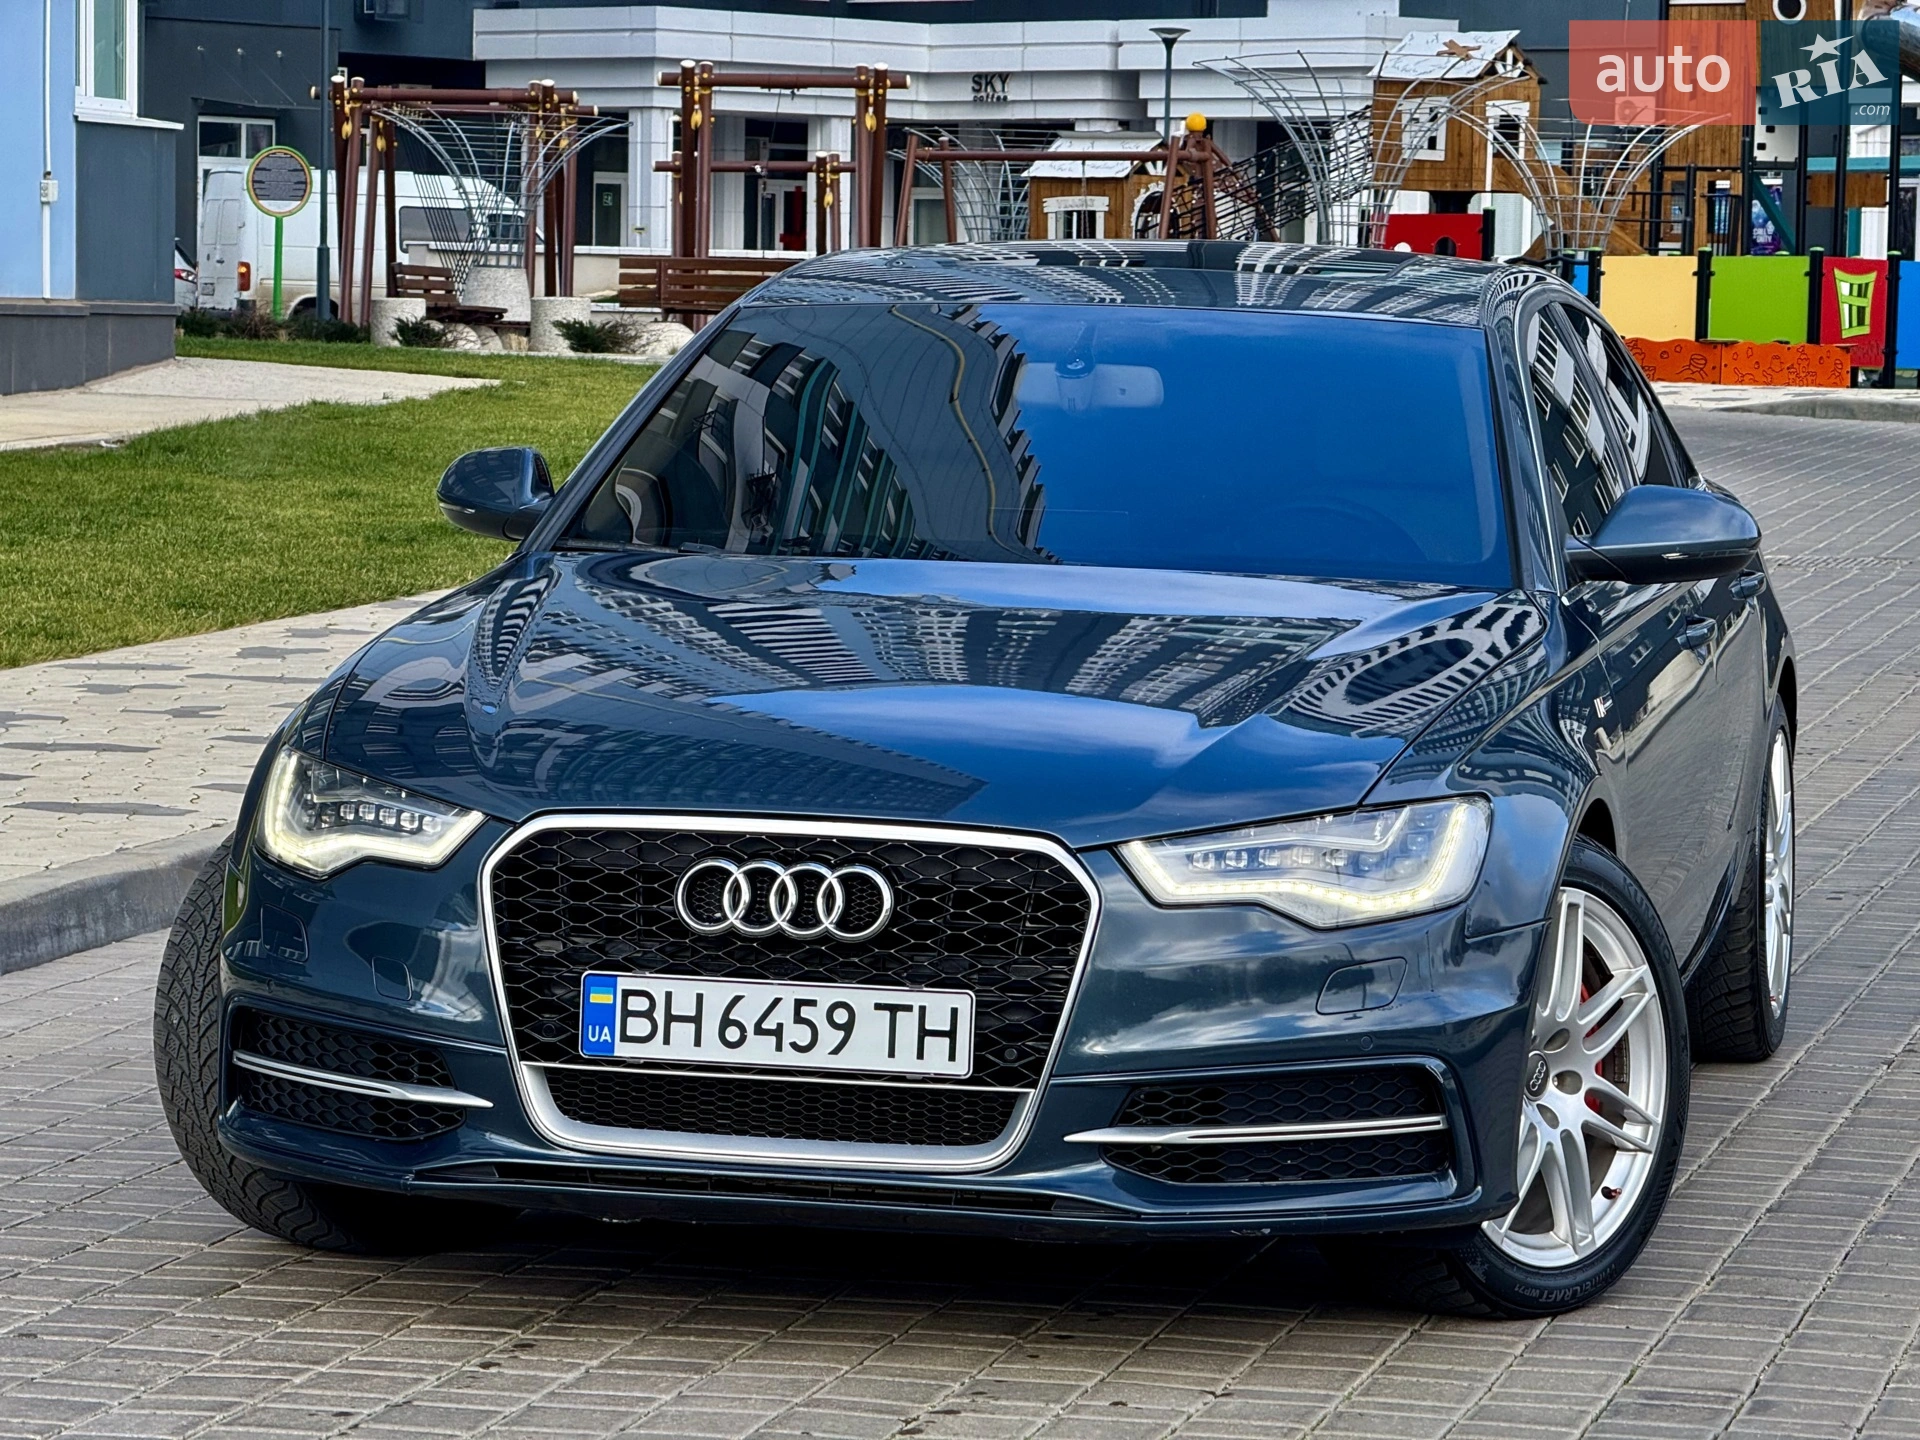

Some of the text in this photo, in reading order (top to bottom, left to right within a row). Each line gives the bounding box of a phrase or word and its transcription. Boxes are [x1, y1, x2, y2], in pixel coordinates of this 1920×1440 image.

[971, 73, 1011, 93] SKY
[973, 93, 1008, 102] coffee
[1623, 875, 1671, 965] KUMHO
[588, 1024, 612, 1044] UA
[619, 988, 959, 1062] BH 6459 TH
[1514, 1283, 1540, 1298] WP71
